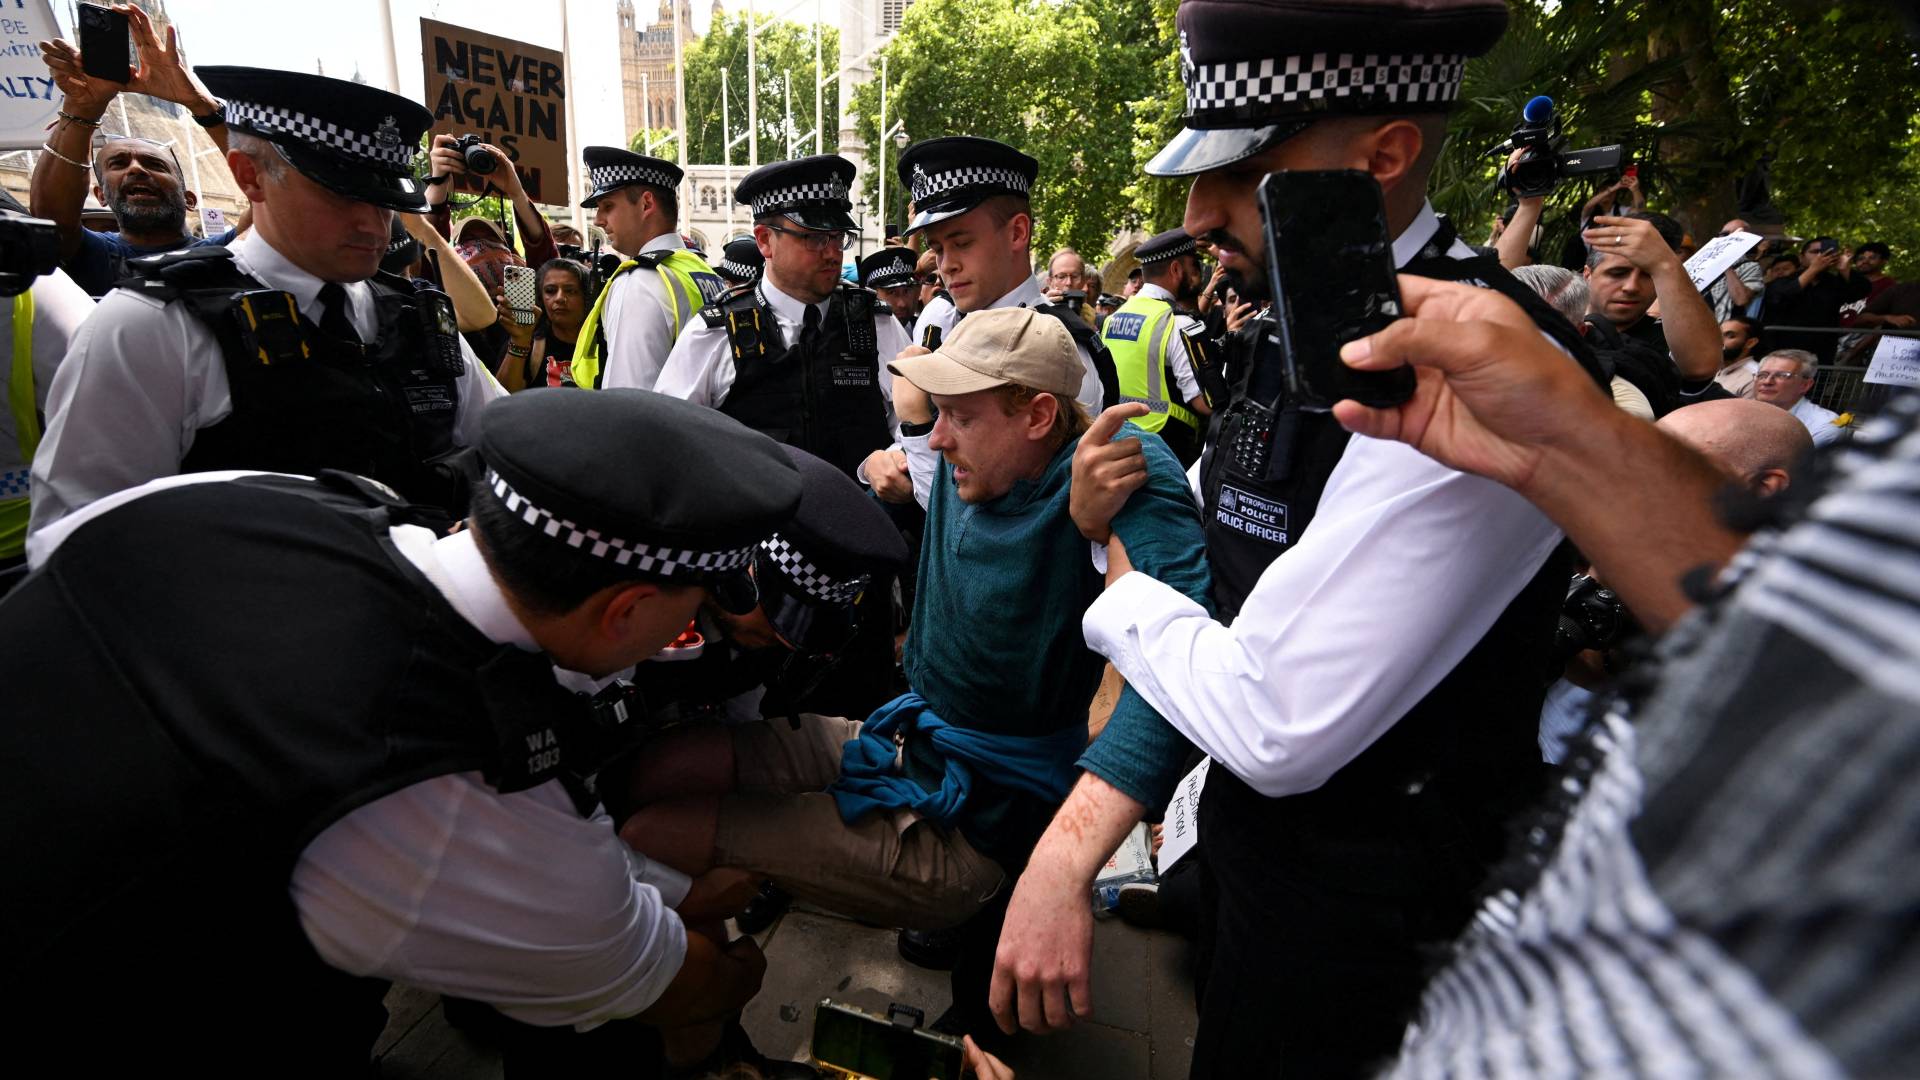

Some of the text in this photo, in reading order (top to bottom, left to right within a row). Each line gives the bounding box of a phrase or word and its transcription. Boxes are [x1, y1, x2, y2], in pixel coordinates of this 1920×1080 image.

[1, 19, 28, 35] BE
[434, 36, 565, 99] NEVER
[434, 81, 557, 141] AGAIN
[1107, 316, 1142, 336] POLICE
[1238, 494, 1284, 515] METROPOLITAN
[1240, 505, 1276, 524] POLICE
[1216, 510, 1287, 544] POLICE OFFICER
[527, 747, 560, 775] 1303
[1173, 796, 1187, 839] ACTION
